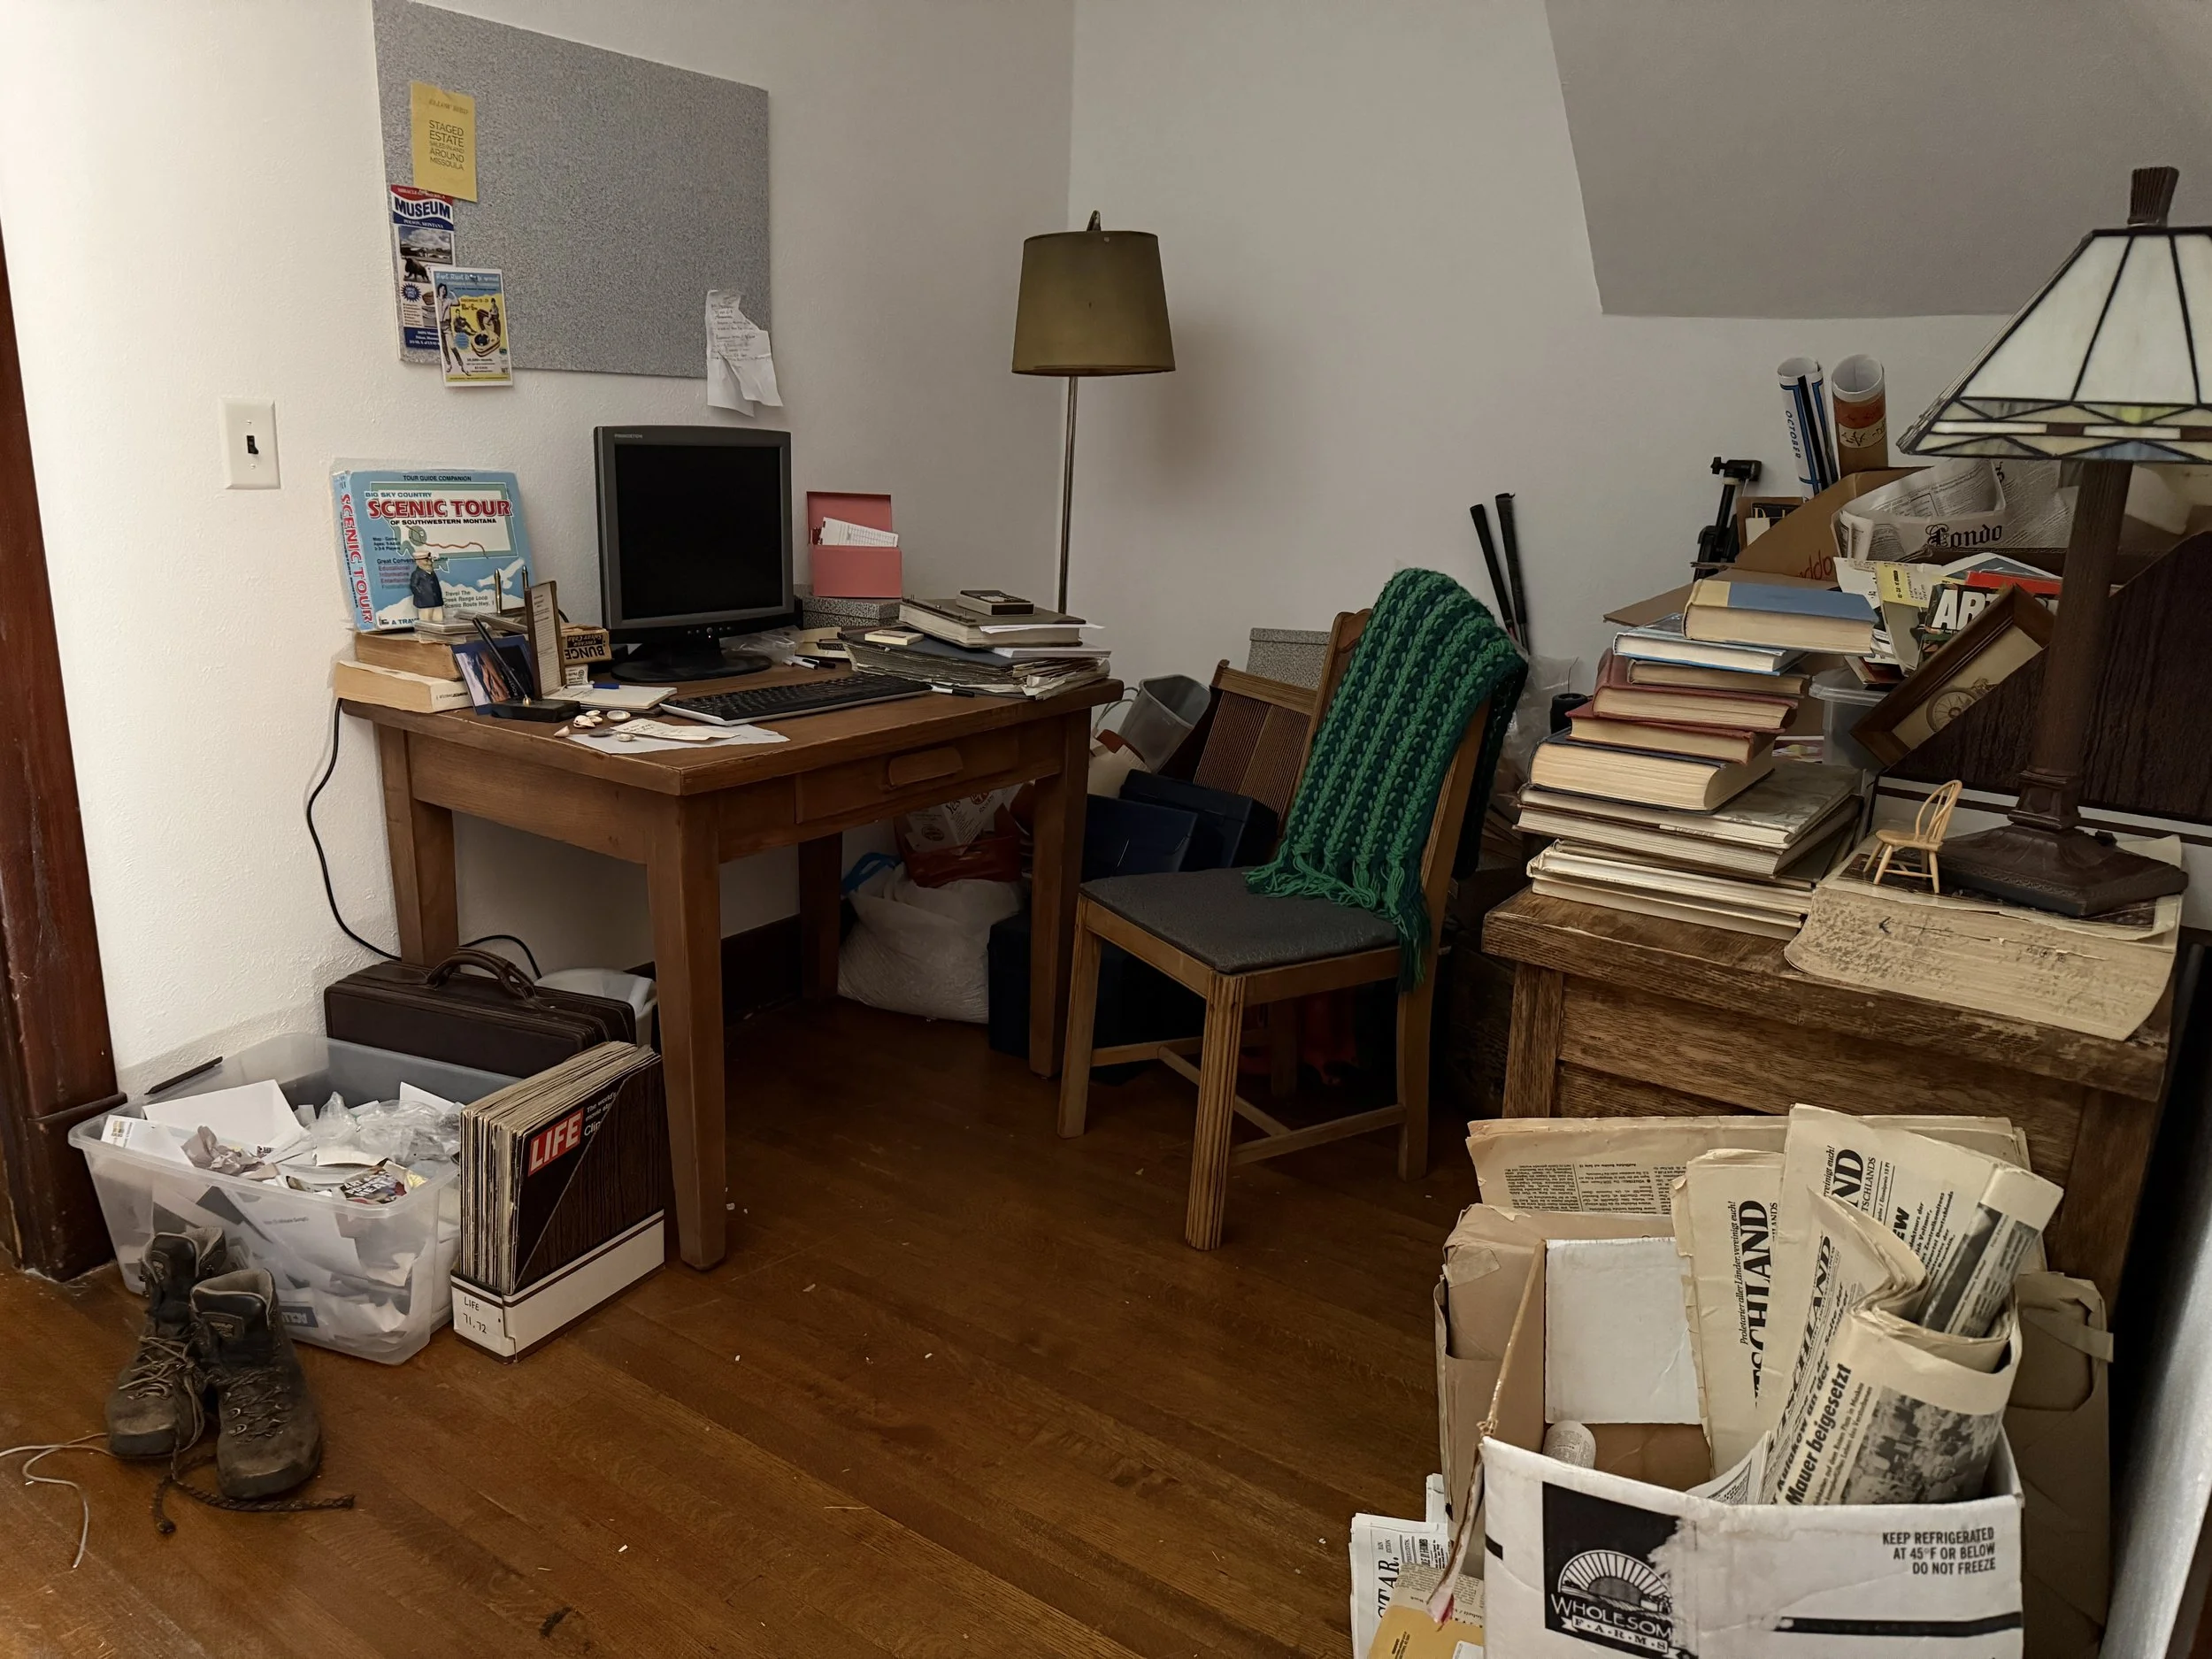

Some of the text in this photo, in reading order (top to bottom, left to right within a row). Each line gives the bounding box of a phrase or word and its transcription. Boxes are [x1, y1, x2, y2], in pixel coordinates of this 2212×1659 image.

[428, 119, 464, 136] STAGED
[429, 130, 465, 148] ESTATE
[429, 147, 465, 163] AROUND
[429, 157, 465, 171] MISSOULA
[395, 196, 451, 219] MUSEUM
[367, 499, 513, 518] SCENIC TOUR
[1925, 523, 2003, 549] Londo
[341, 493, 373, 624] SCENIC TOUR
[564, 645, 605, 660] BUNGE
[584, 1121, 601, 1136] Clin
[530, 1112, 582, 1172] LIFE
[1826, 1145, 1836, 1167] euch!
[1861, 1156, 1876, 1211] TSCHLANDS
[1893, 1206, 1910, 1240] EW
[1924, 1192, 1945, 1250] Zentralkomitees
[1935, 1191, 1954, 1238] Deutschlands
[1731, 1222, 1740, 1256] vereinigt
[464, 1295, 480, 1312] LIFE
[1739, 1200, 1771, 1399] TSCHLAND
[1740, 1303, 1748, 1345] Proletarier
[1816, 1361, 1830, 1391] der
[1786, 1452, 1818, 1505] Mauer
[1806, 1363, 1852, 1454] beigesetzt
[1882, 1526, 1994, 1545] KEEP REFRIGERATED
[1893, 1548, 1908, 1560] AT
[1940, 1548, 1956, 1559] OR
[1960, 1542, 1995, 1556] BELOW
[1912, 1557, 1996, 1575] DO NOT FREEZE
[1551, 1594, 1673, 1638] WHOLESOM
